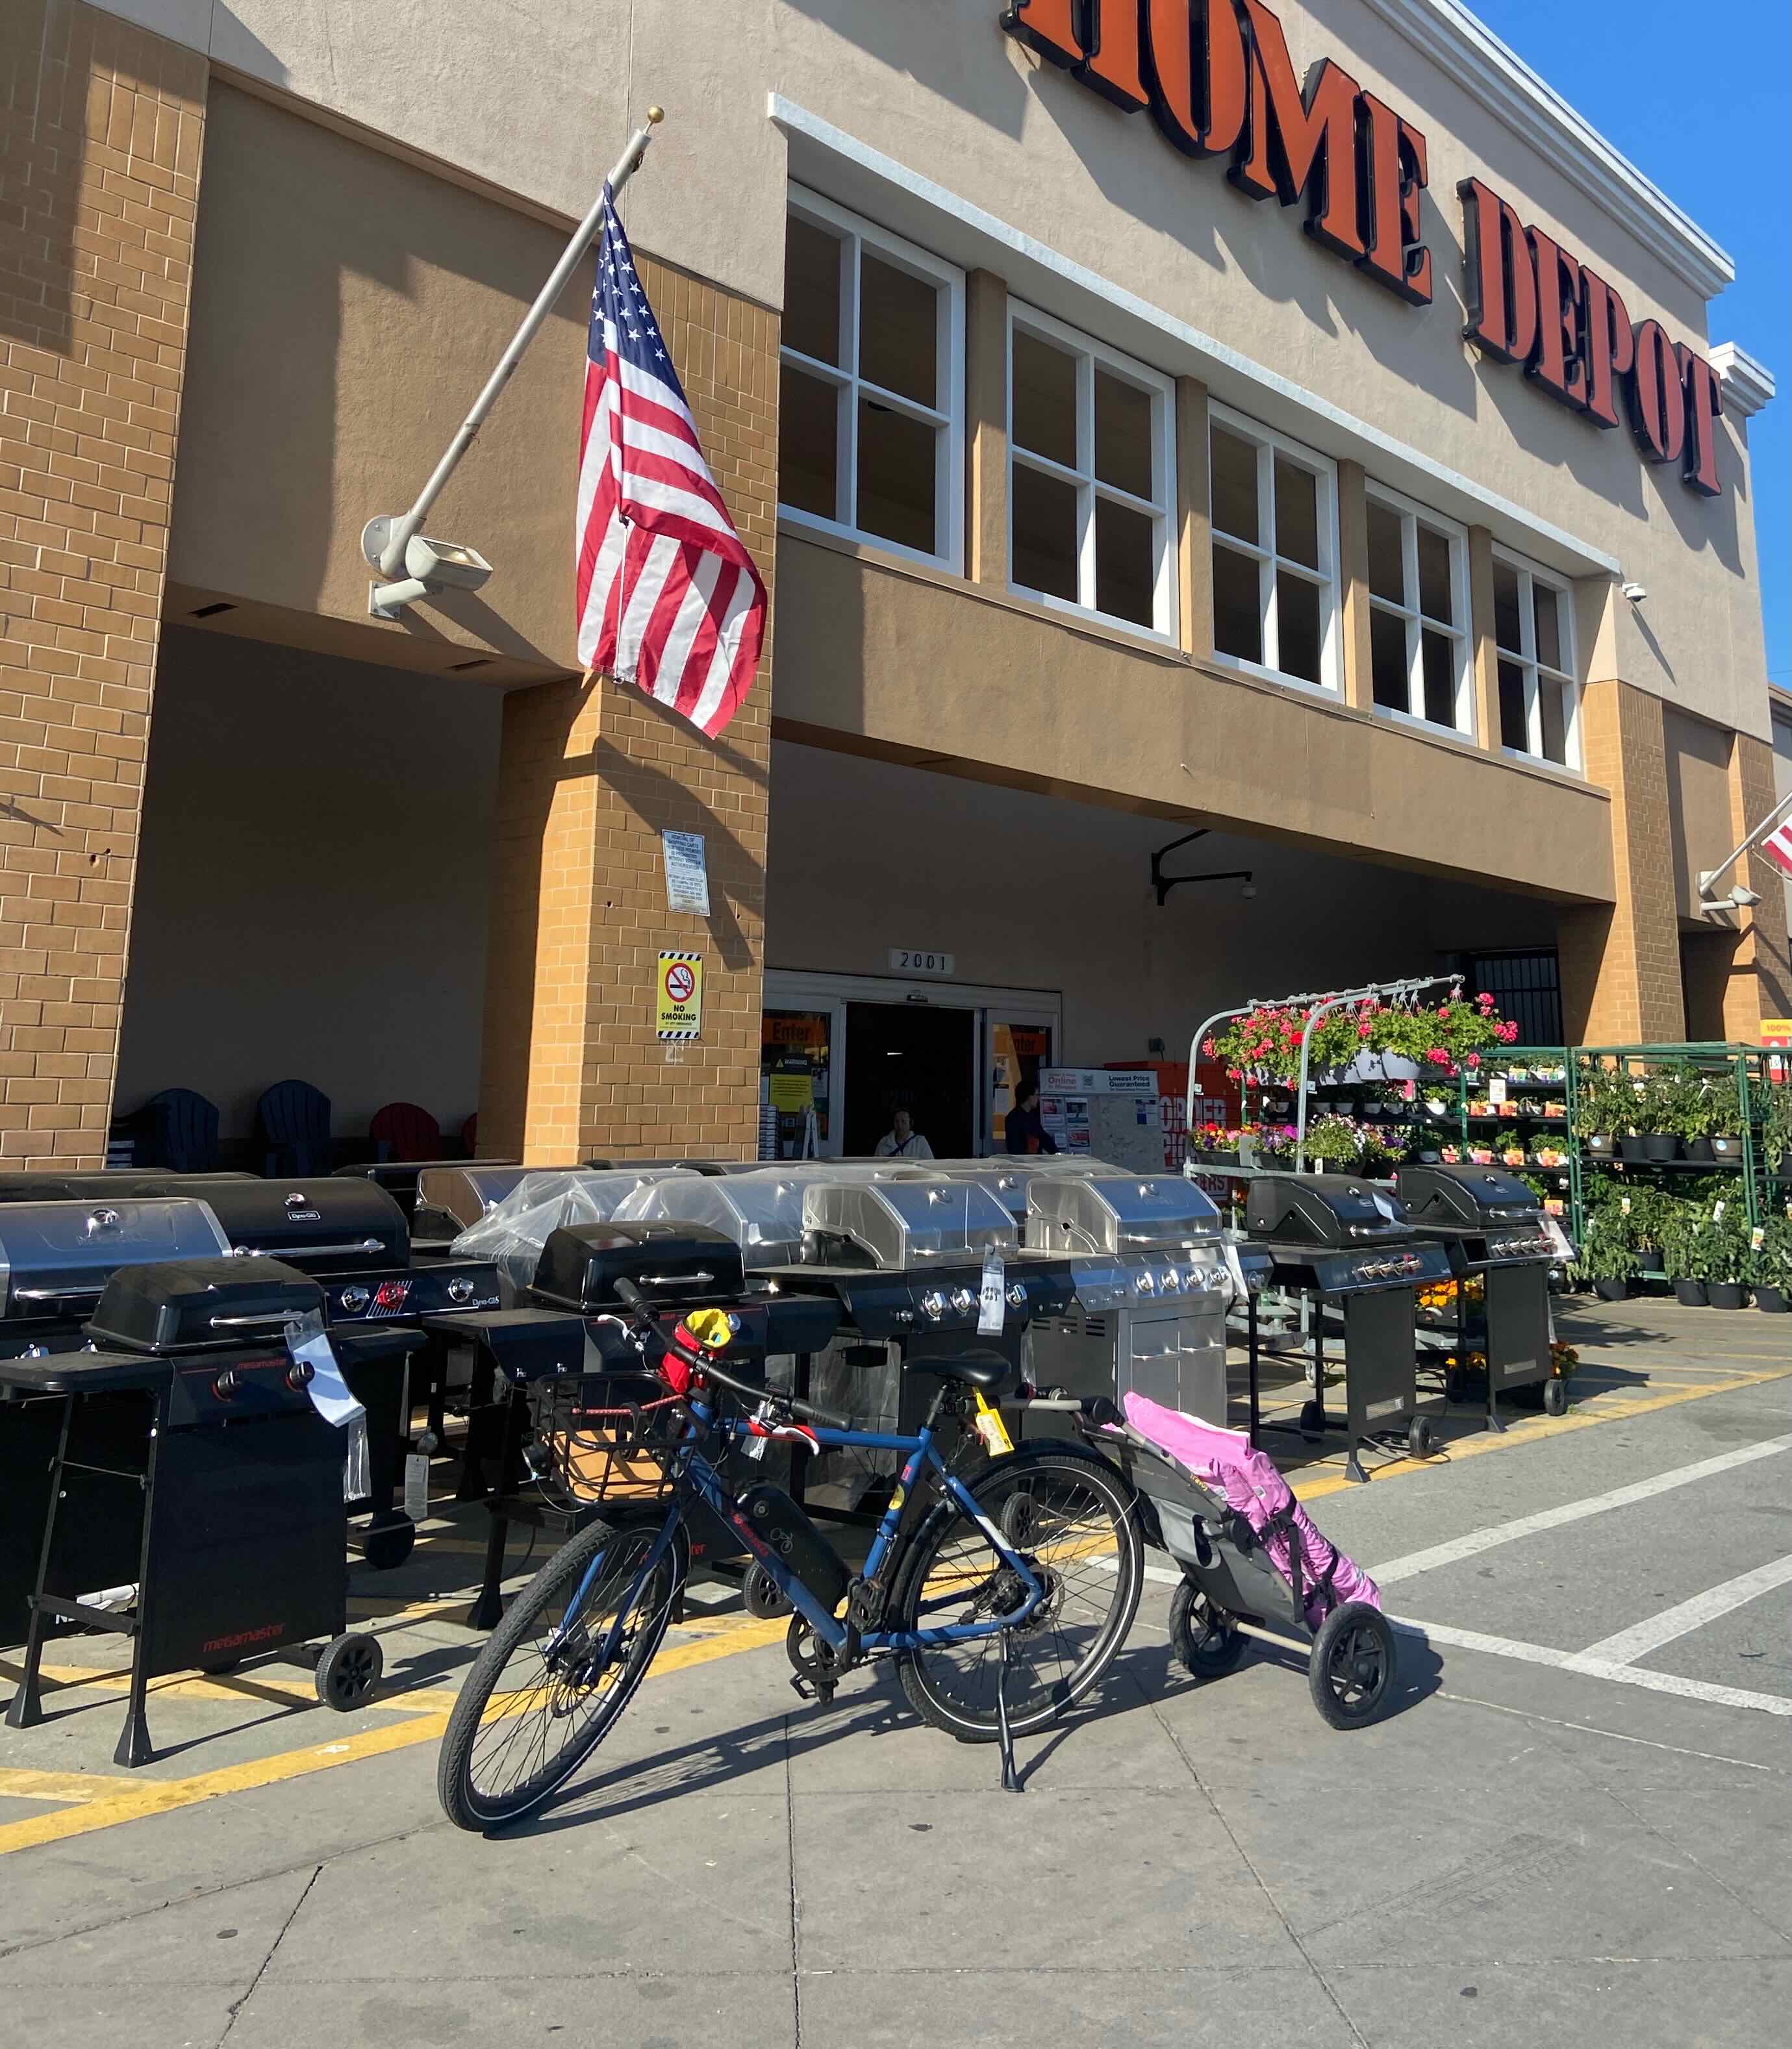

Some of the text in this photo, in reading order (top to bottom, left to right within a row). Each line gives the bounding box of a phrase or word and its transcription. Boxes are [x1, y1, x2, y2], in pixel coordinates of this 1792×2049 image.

[1456, 176, 1722, 496] DEPOT
[900, 952, 945, 970] 2001
[661, 1012, 696, 1021] SMOKING
[774, 1022, 811, 1041] Enter
[1048, 1074, 1076, 1085] Online
[203, 1623, 286, 1653] megamaster
